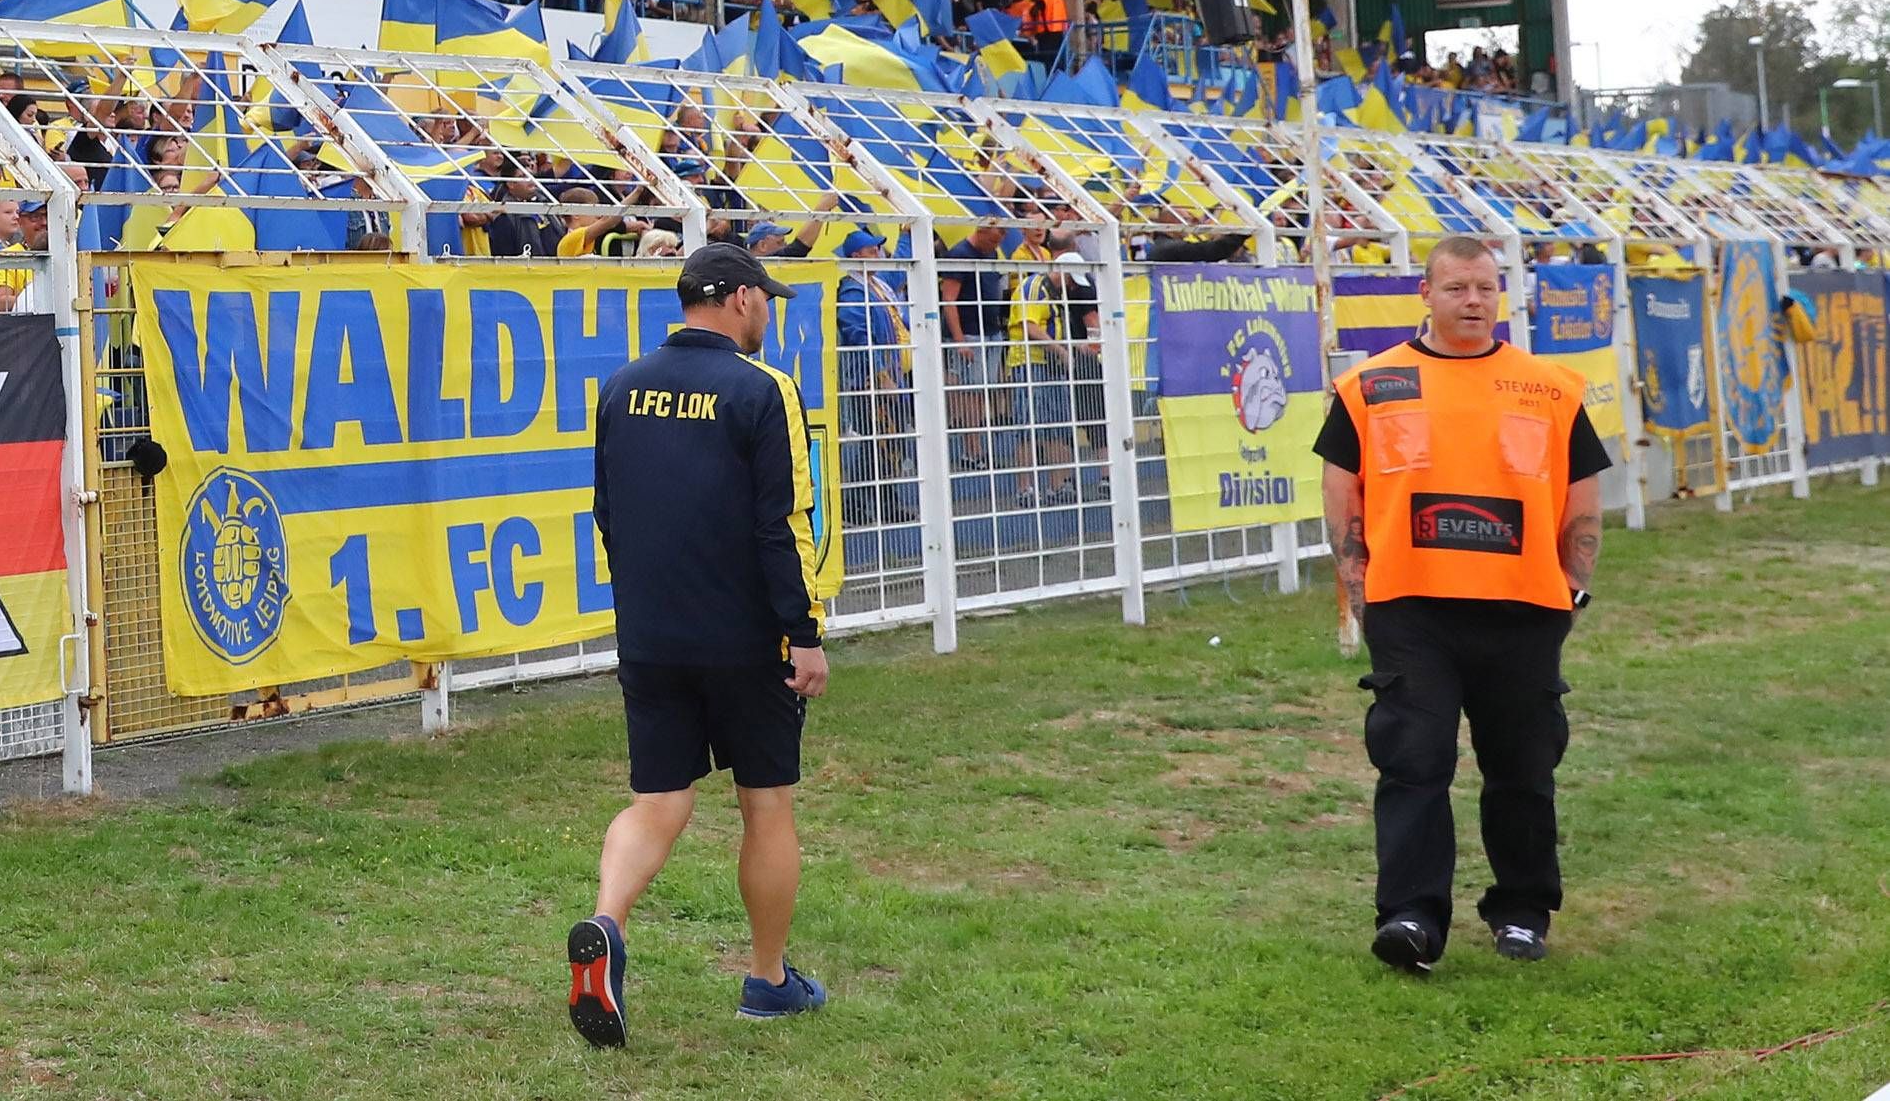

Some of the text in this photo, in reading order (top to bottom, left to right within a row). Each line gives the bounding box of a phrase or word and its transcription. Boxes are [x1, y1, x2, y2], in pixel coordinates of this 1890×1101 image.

[152, 281, 825, 454] WALDHM
[627, 388, 719, 421] 1.FC LOK
[1437, 517, 1513, 537] EVENTS
[329, 534, 425, 646] 1.
[446, 516, 544, 635] FC
